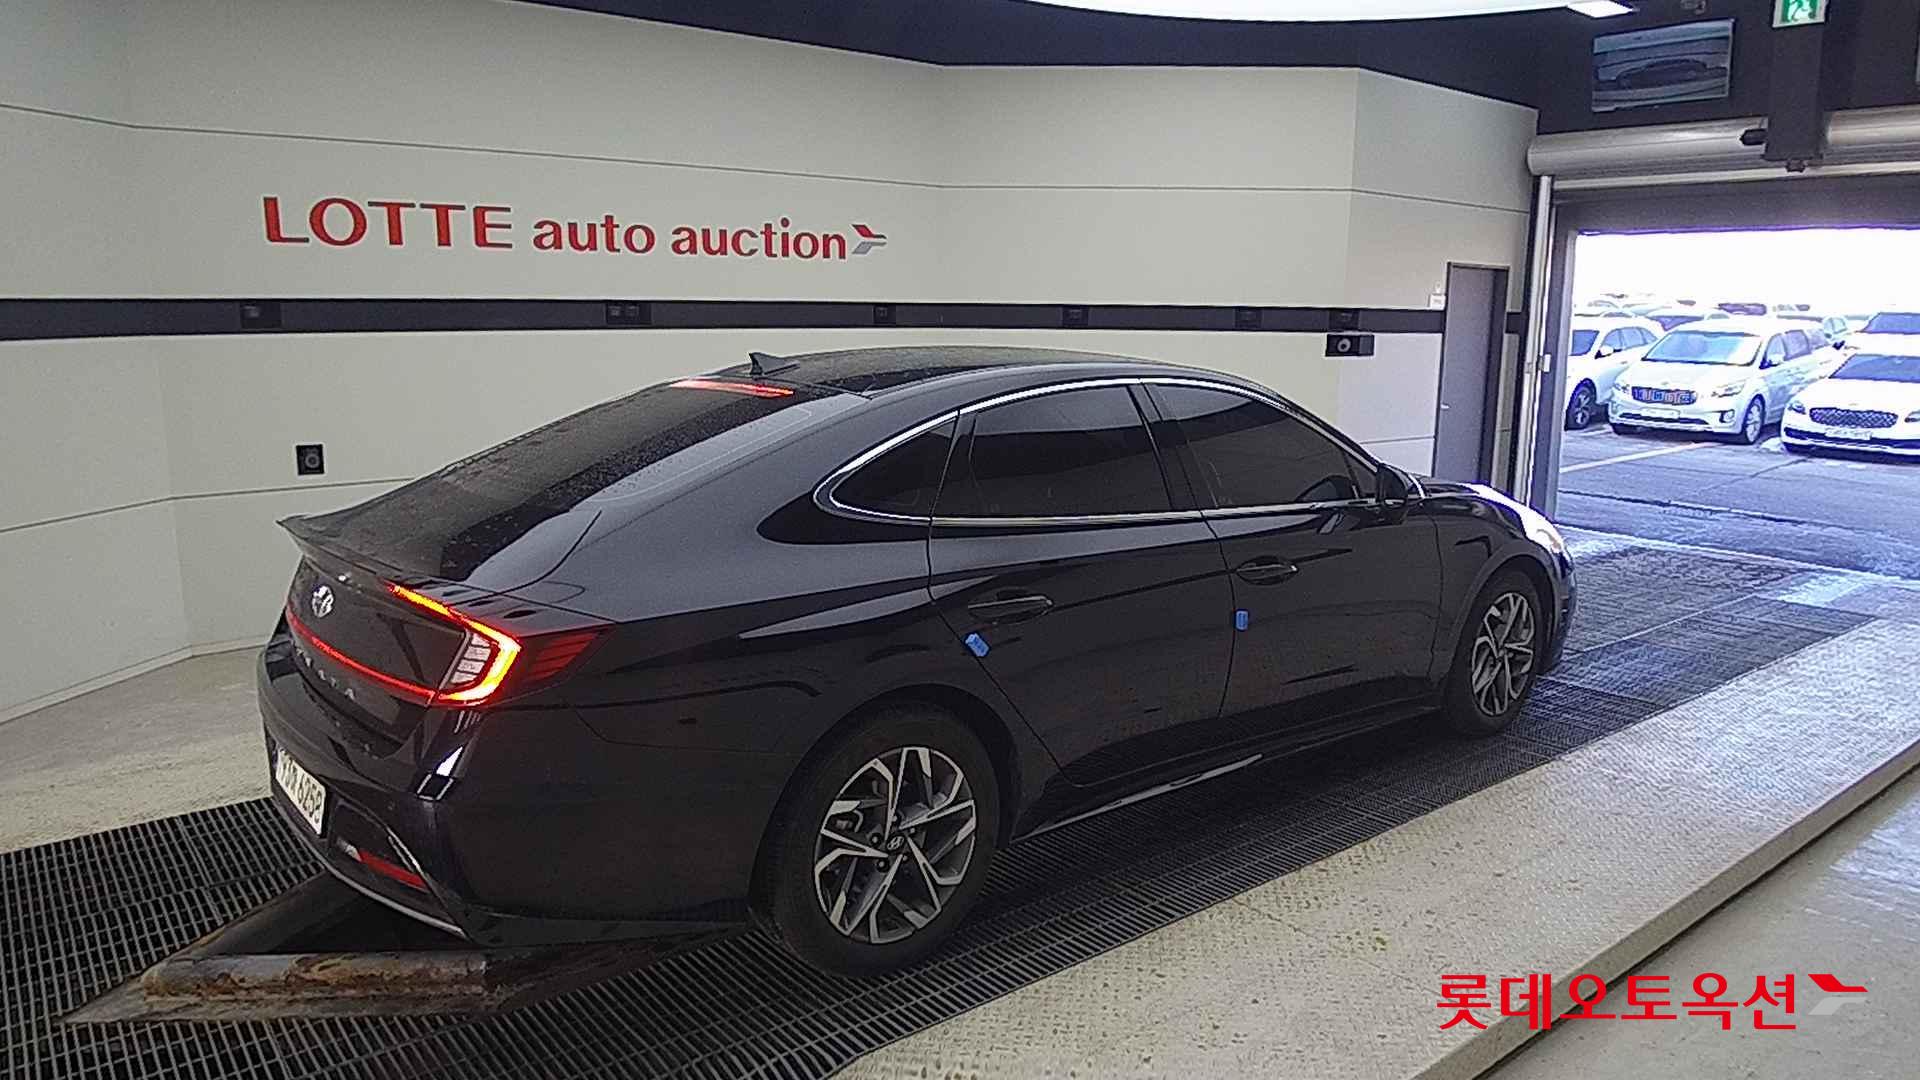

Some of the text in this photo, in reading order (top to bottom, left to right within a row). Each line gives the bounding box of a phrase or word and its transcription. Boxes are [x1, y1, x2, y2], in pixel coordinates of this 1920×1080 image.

[263, 196, 847, 259] LOTTE auto auction
